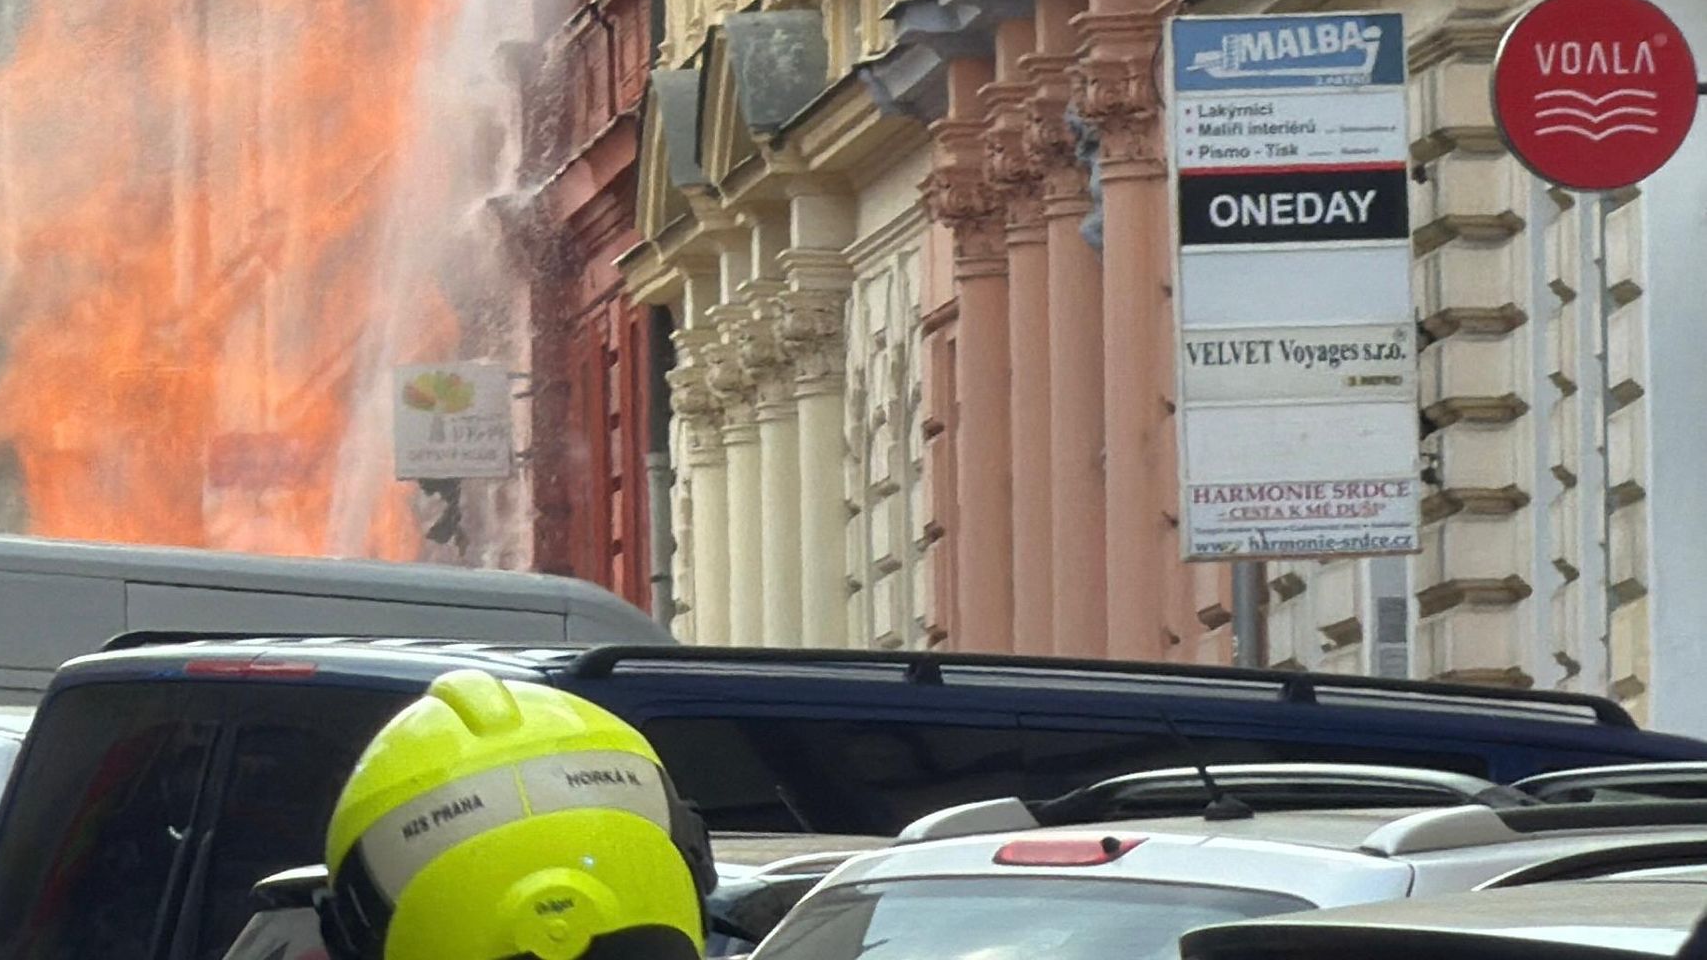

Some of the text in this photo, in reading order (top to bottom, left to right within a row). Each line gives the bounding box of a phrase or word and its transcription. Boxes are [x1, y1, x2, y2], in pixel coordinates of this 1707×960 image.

[1238, 21, 1364, 62] MALBA
[1535, 41, 1655, 75] VOALA
[1209, 190, 1376, 227] ONEDAY
[1186, 339, 1406, 369] VELVET Voyages s.r.o.
[1193, 481, 1409, 504] HARMONIE SRDCE
[431, 794, 485, 827] PRAHA
